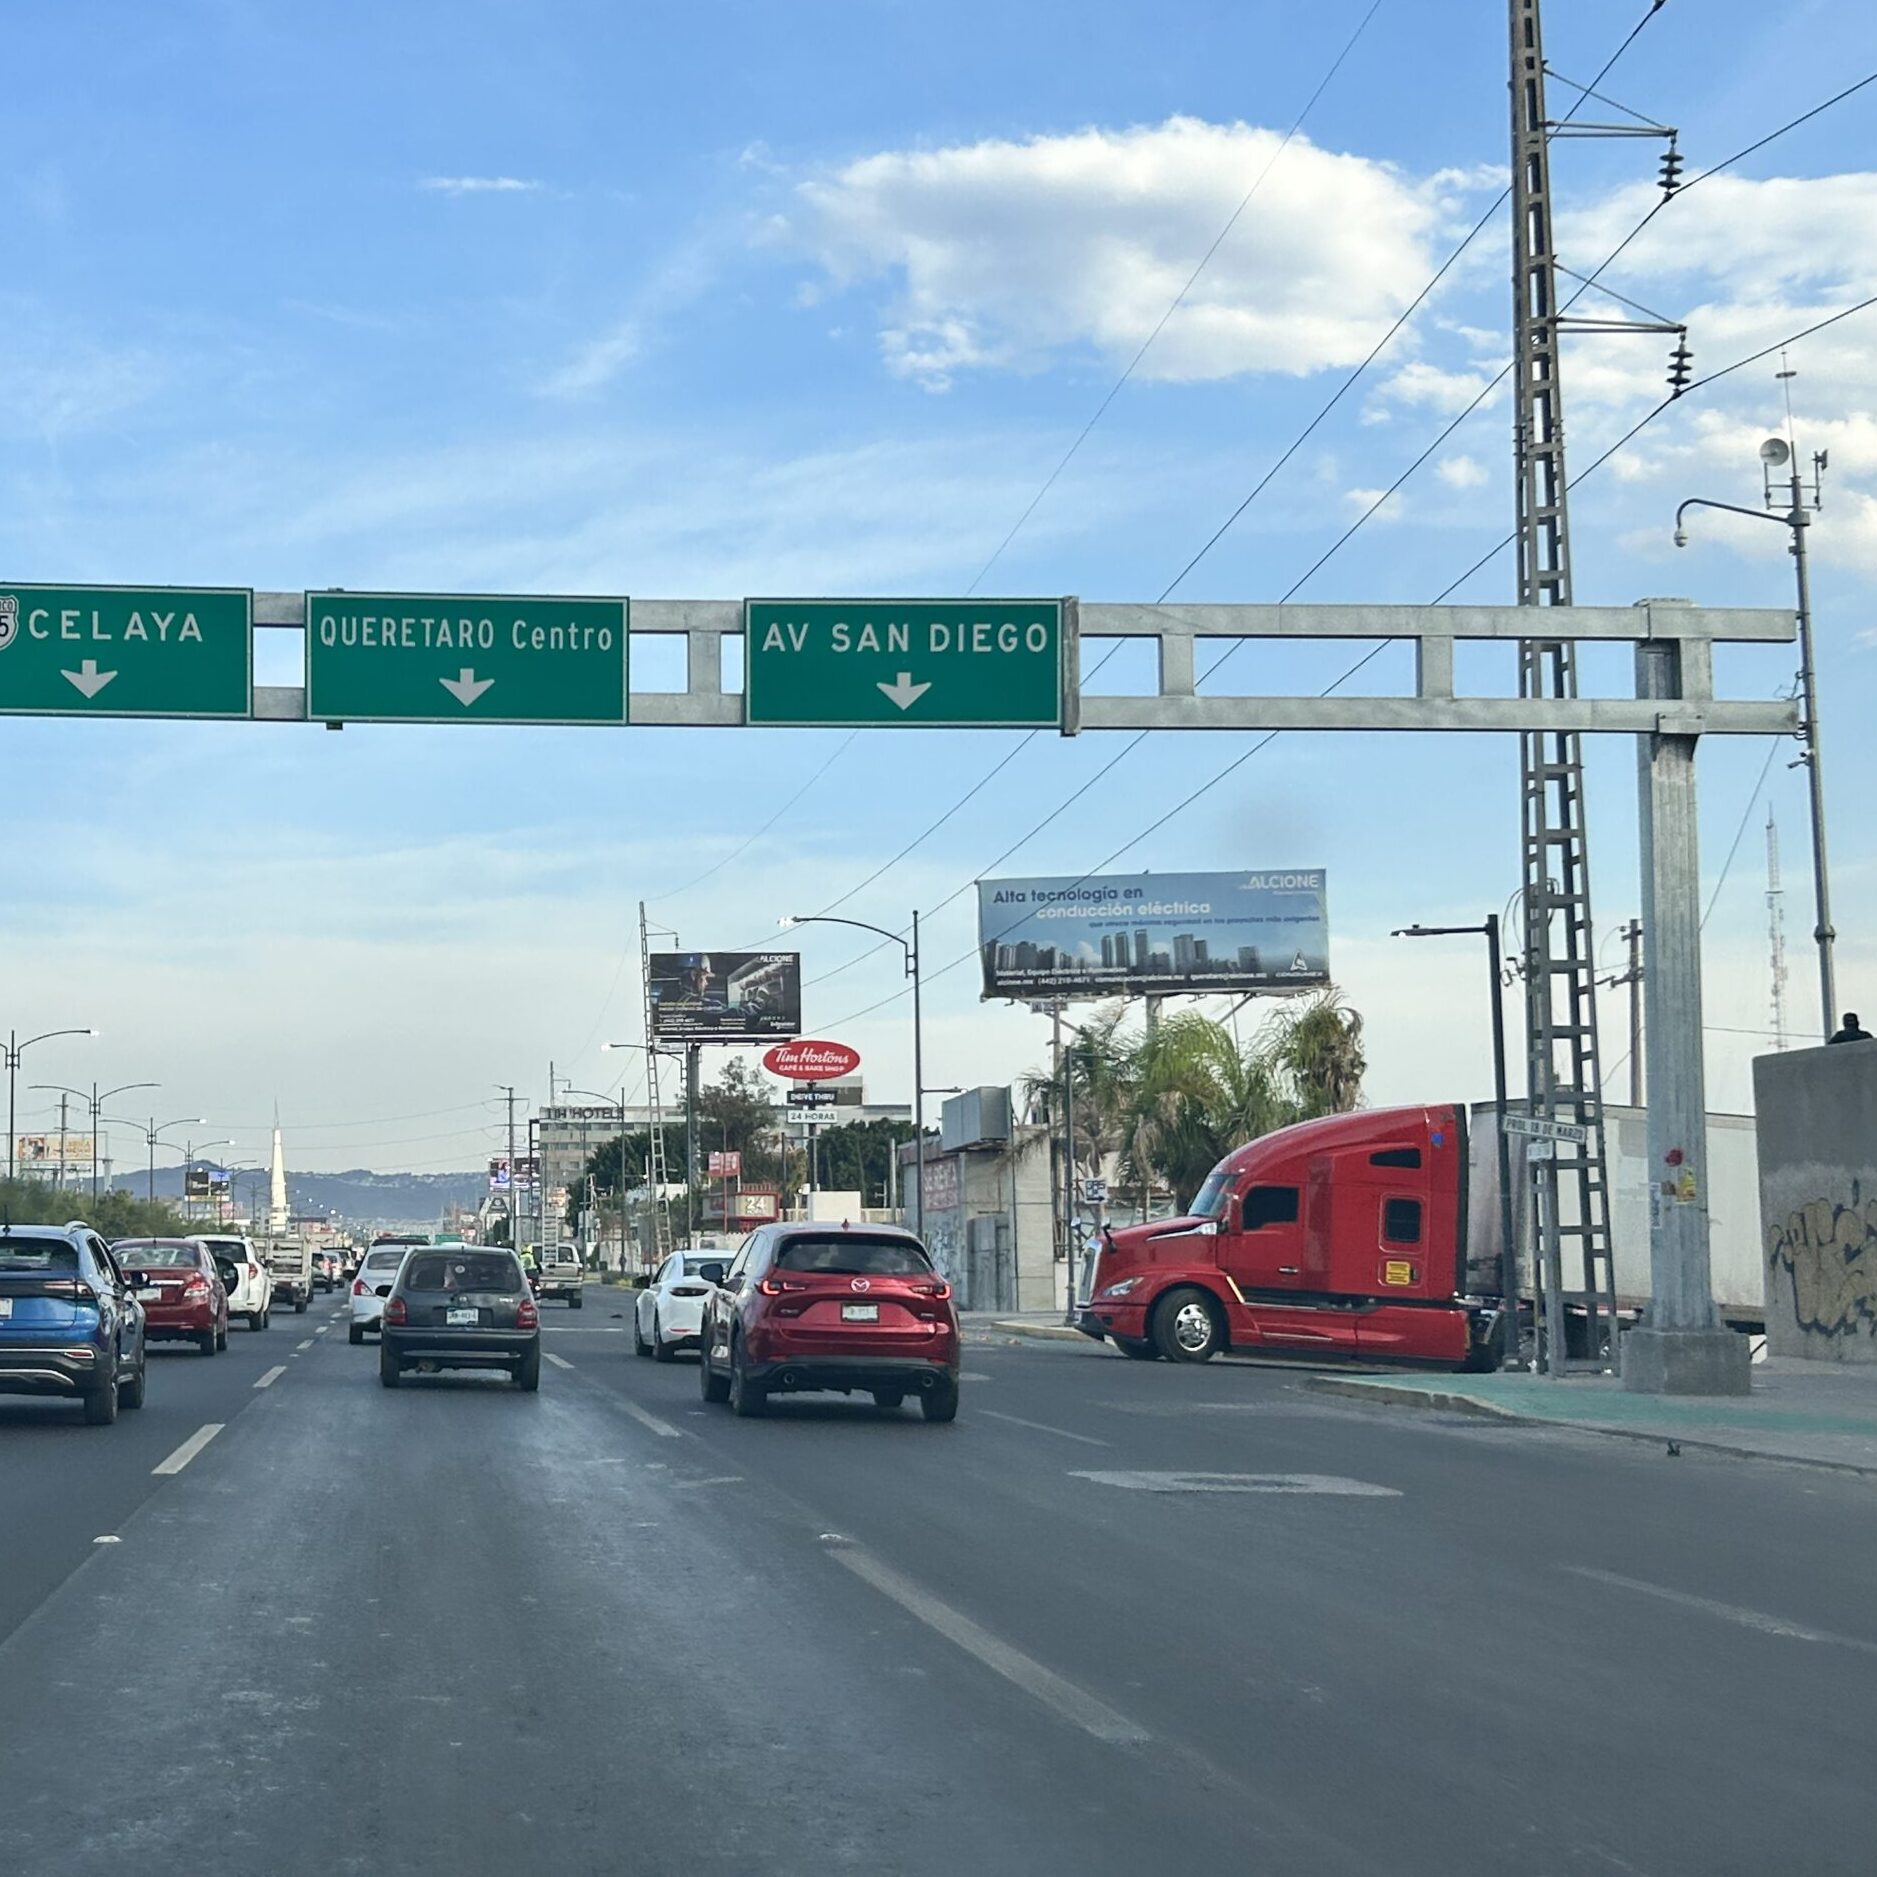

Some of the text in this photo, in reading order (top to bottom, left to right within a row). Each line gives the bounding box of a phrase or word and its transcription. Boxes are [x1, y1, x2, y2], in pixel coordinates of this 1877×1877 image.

[29, 609, 203, 642] CELAYA
[320, 616, 612, 650] QUERETARO Centro
[762, 623, 1047, 652] AV SAN DIEGO
[1249, 874, 1319, 889] ALCIONE
[993, 886, 1143, 903] Alta tecnología en
[1036, 901, 1210, 919] conducción eléctrica
[775, 1047, 849, 1064] Tim Hortons
[746, 1197, 765, 1209] 24
